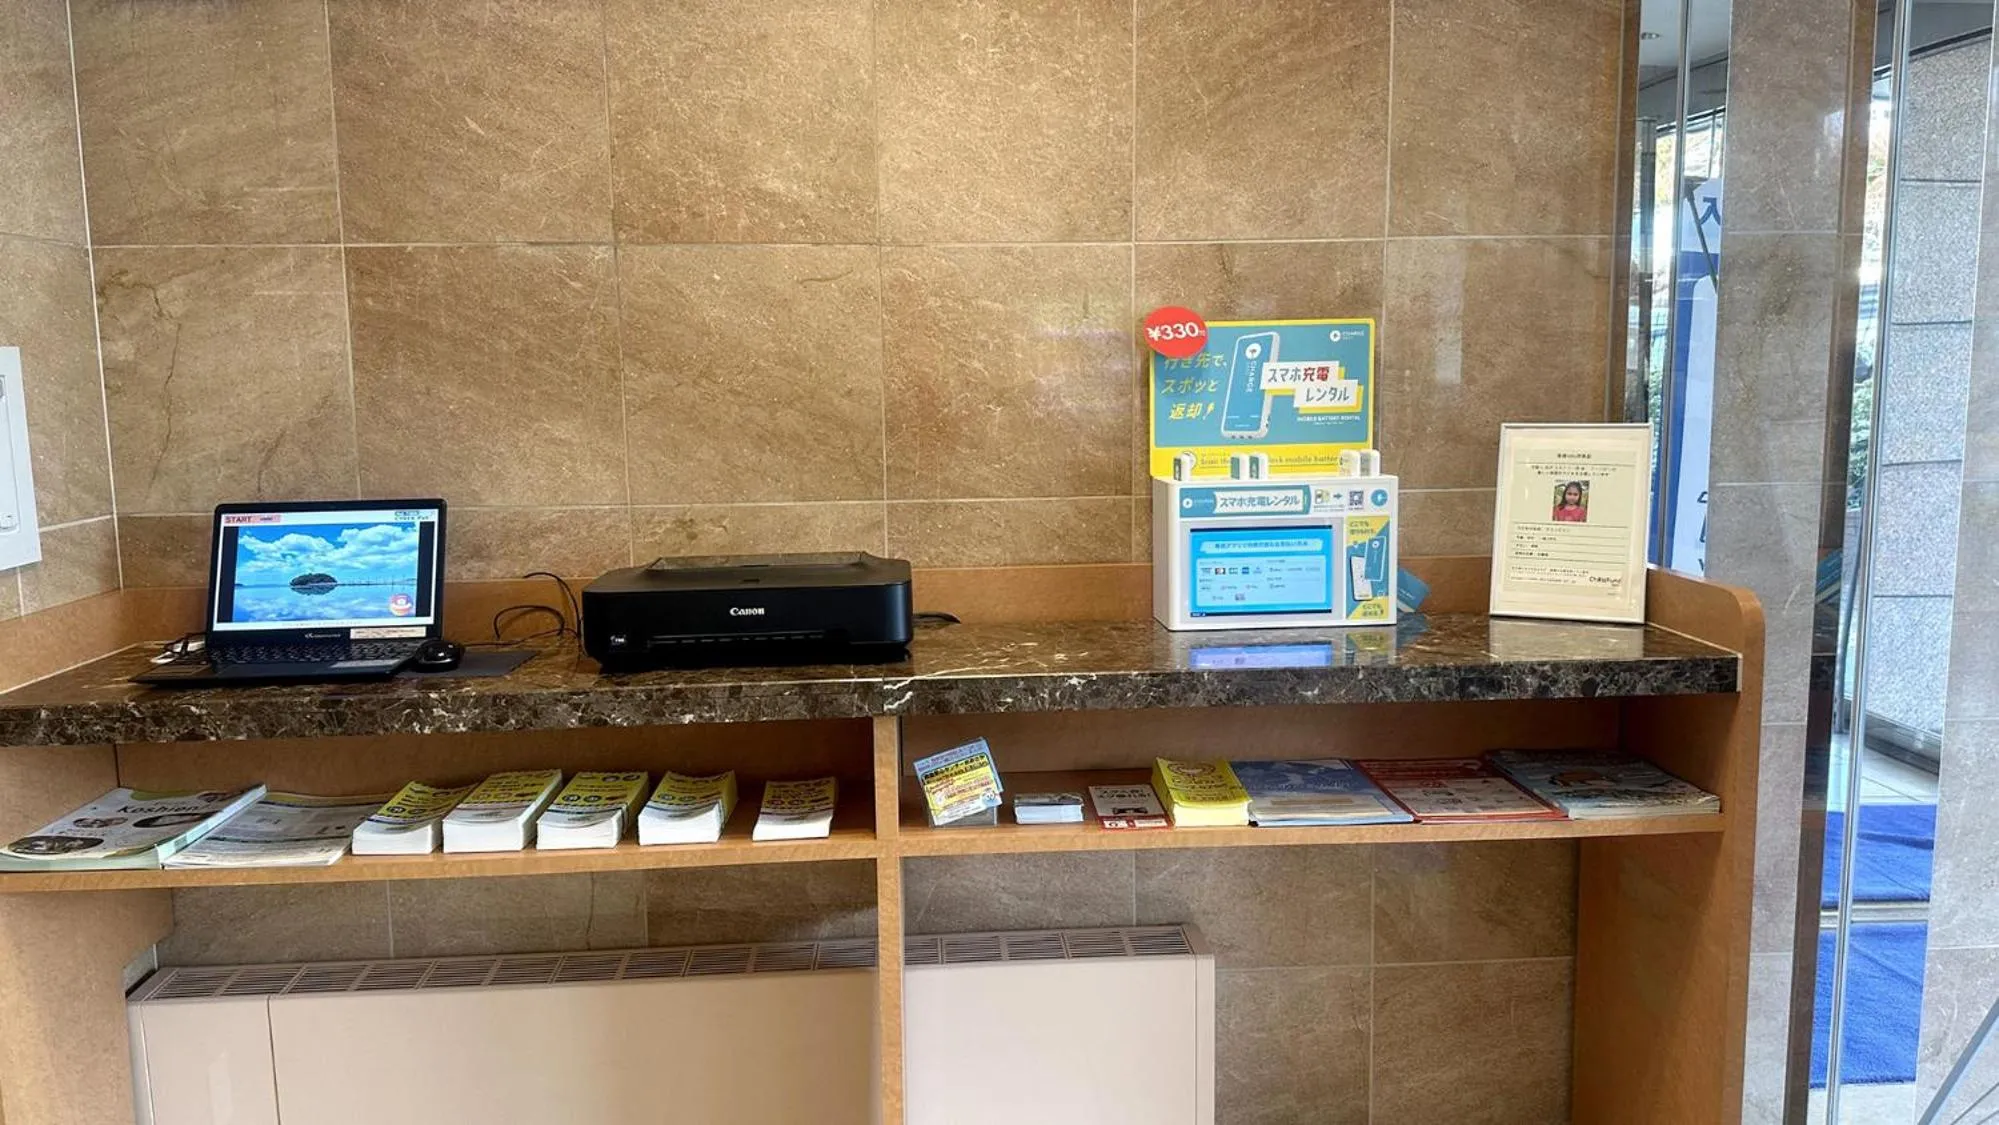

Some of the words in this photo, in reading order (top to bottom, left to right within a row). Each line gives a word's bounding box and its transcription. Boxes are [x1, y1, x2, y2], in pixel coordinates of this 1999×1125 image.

[1146, 321, 1199, 341] ¥330
[1268, 366, 1330, 382] スマホ充電
[1306, 387, 1349, 402] レンタル
[1220, 495, 1299, 507] スマホ充電レンタル
[730, 607, 765, 616] Canon
